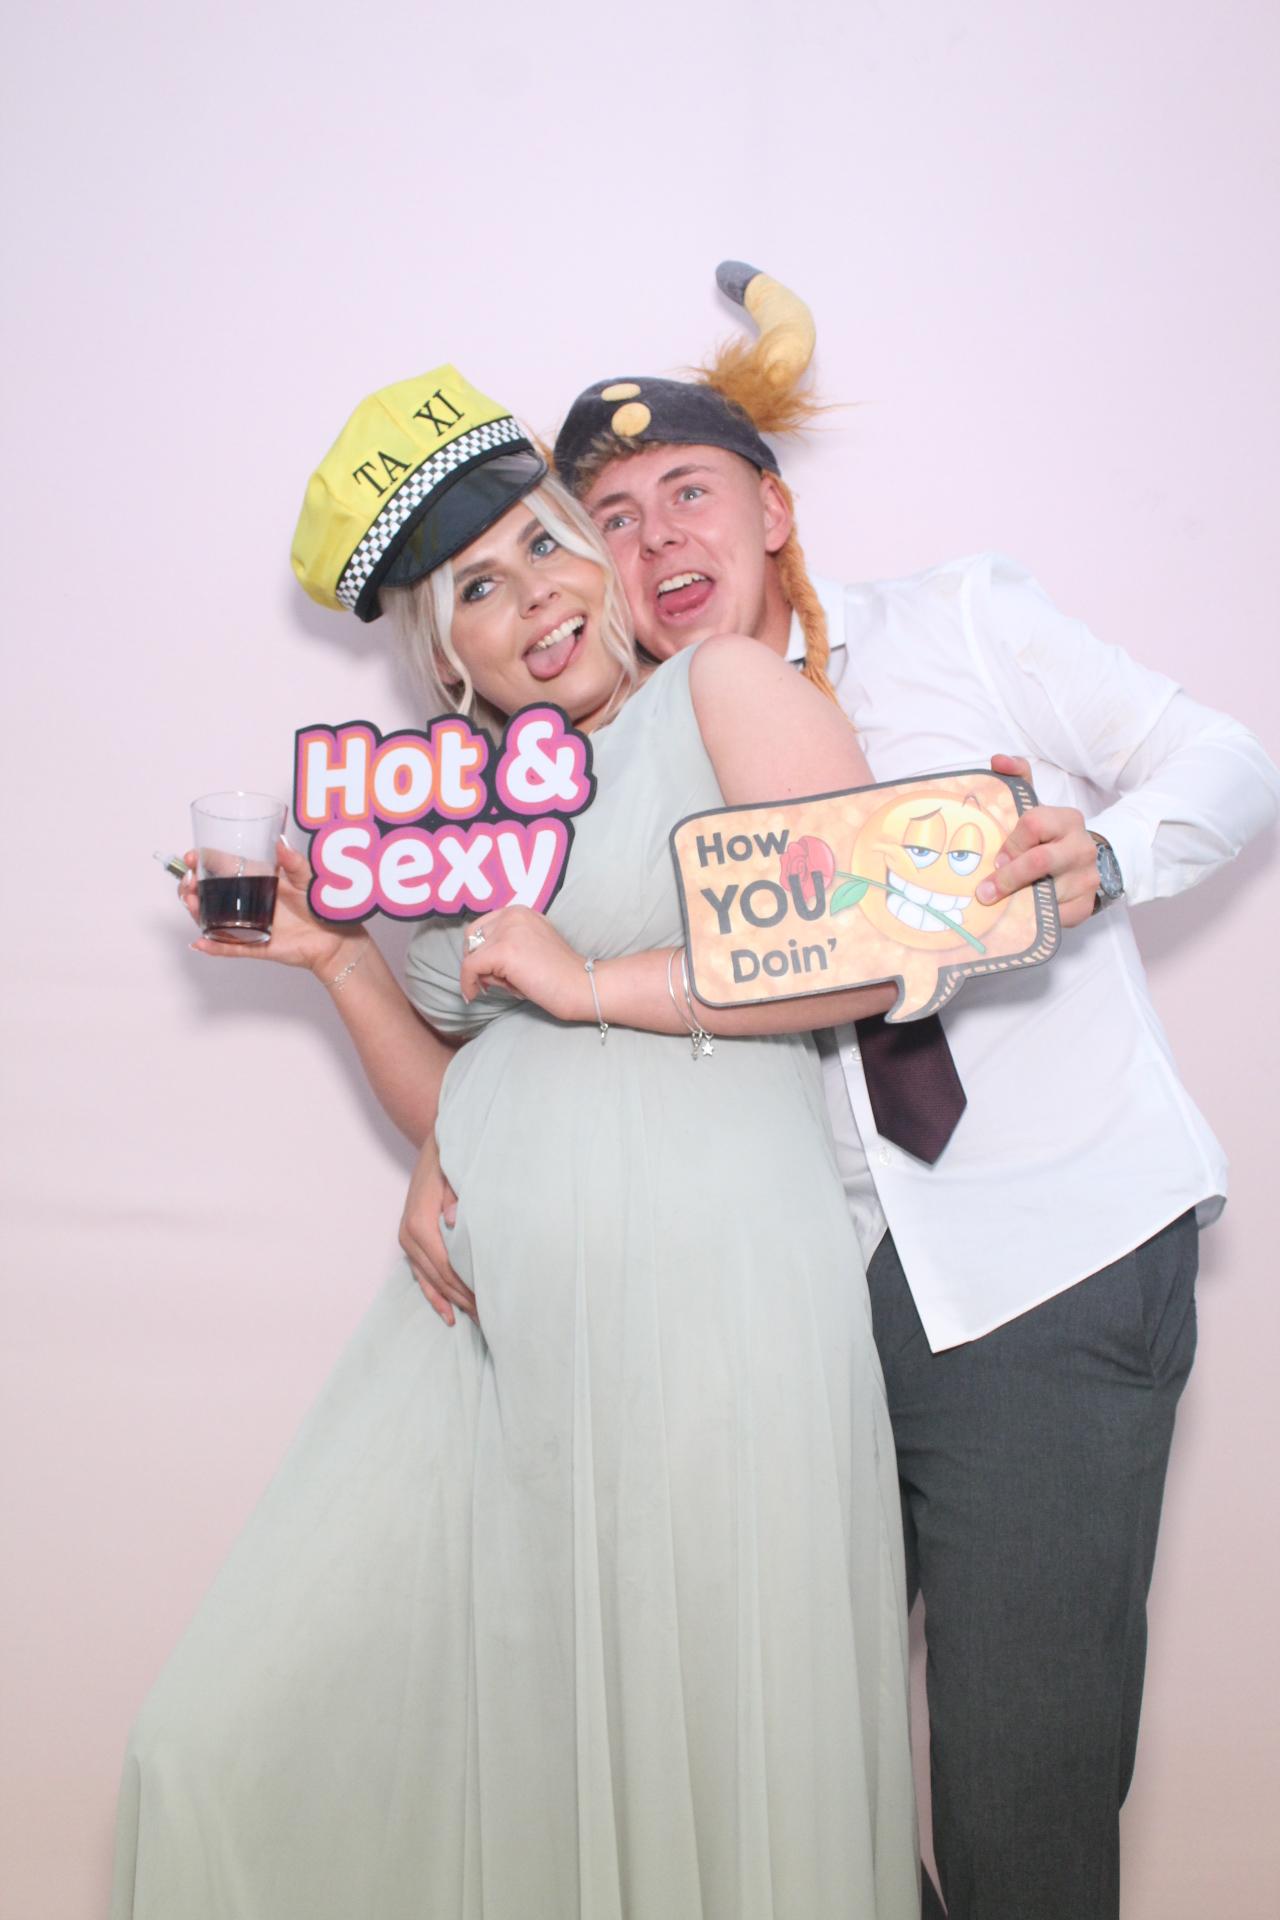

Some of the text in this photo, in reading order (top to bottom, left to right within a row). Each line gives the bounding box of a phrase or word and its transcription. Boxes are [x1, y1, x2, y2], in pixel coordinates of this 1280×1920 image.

[306, 720, 579, 818] Hot &
[320, 827, 557, 909] Sexy
[695, 829, 790, 868] How
[700, 870, 826, 935] YOU
